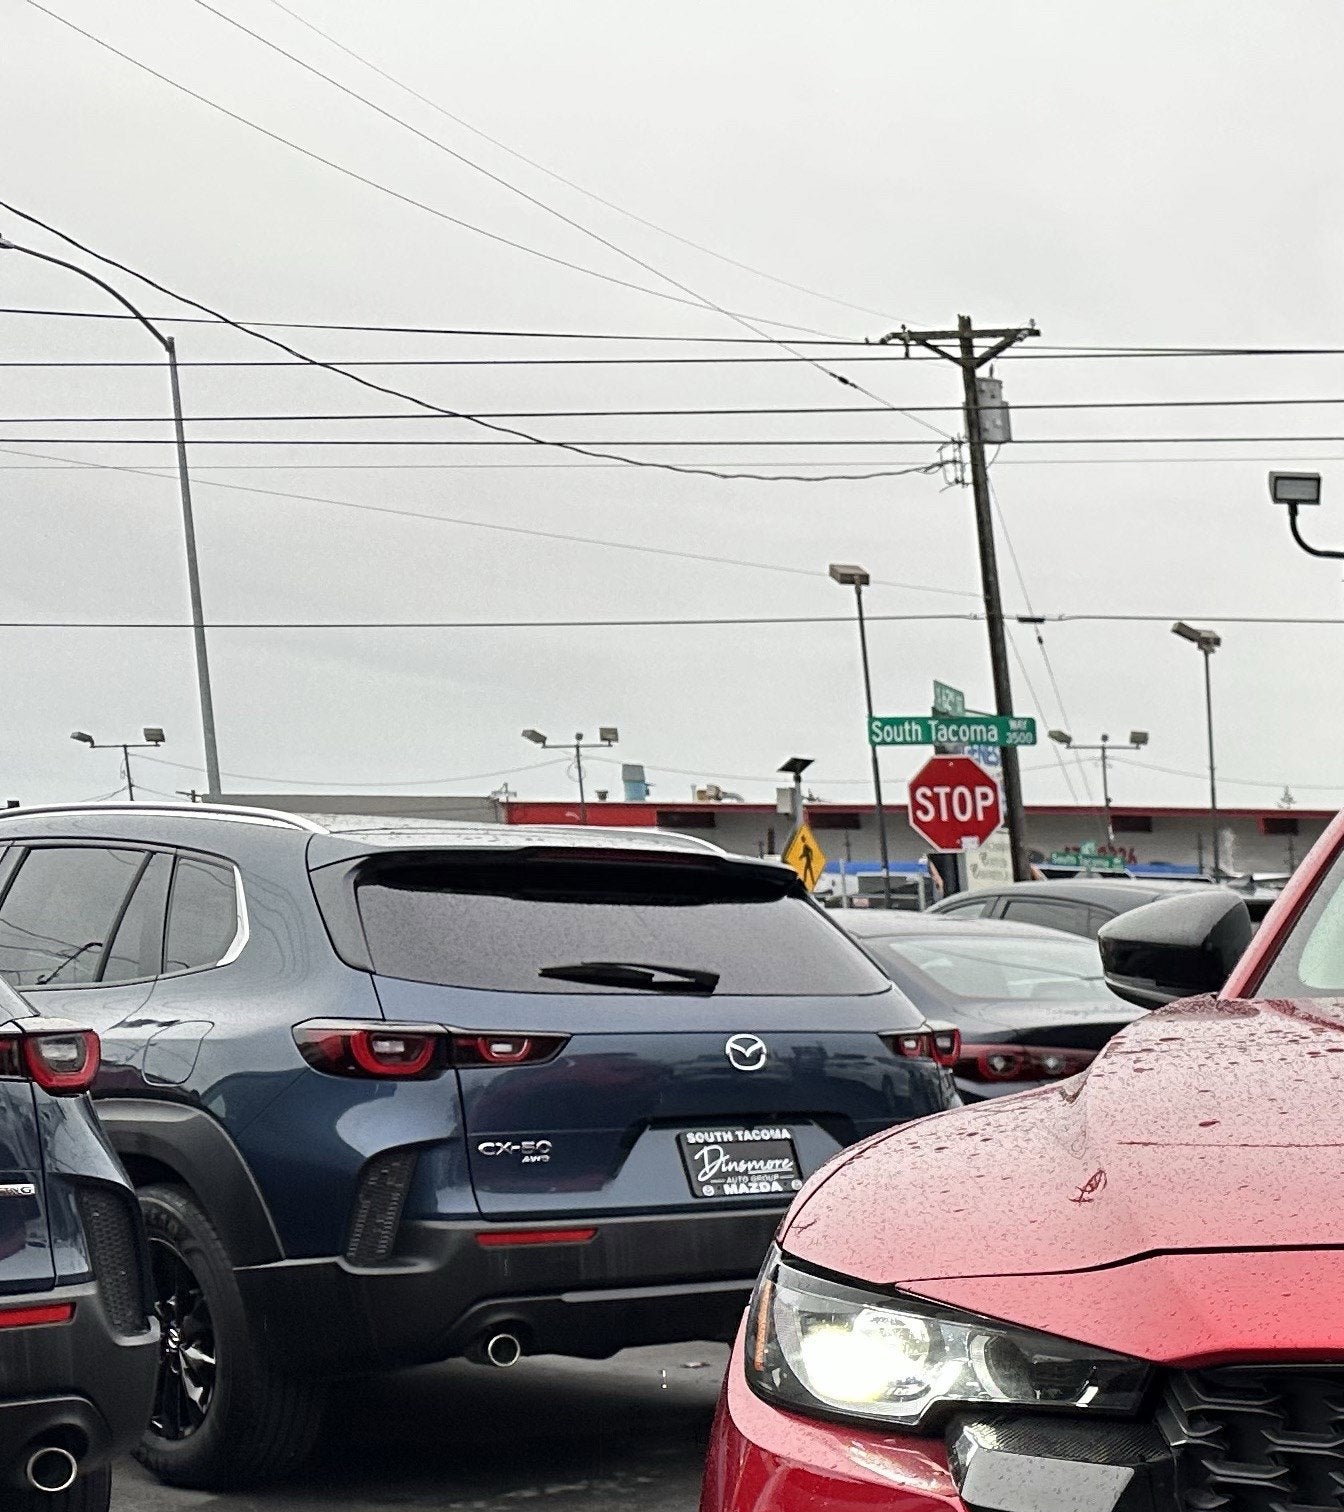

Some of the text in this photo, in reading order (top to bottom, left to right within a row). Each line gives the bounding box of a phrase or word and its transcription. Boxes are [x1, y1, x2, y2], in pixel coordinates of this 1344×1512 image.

[871, 719, 998, 743] South Tacoma
[1008, 719, 1027, 731] WAY
[1006, 731, 1033, 744] 3500
[915, 785, 995, 822] STOP
[686, 1128, 791, 1144] SOUTH TACOMA
[478, 1140, 552, 1156] CX-50
[522, 1155, 550, 1163] AWD
[694, 1144, 793, 1181] Dinsmore
[726, 1173, 779, 1184] AUTO GROUP
[723, 1181, 783, 1195] MAZDA
